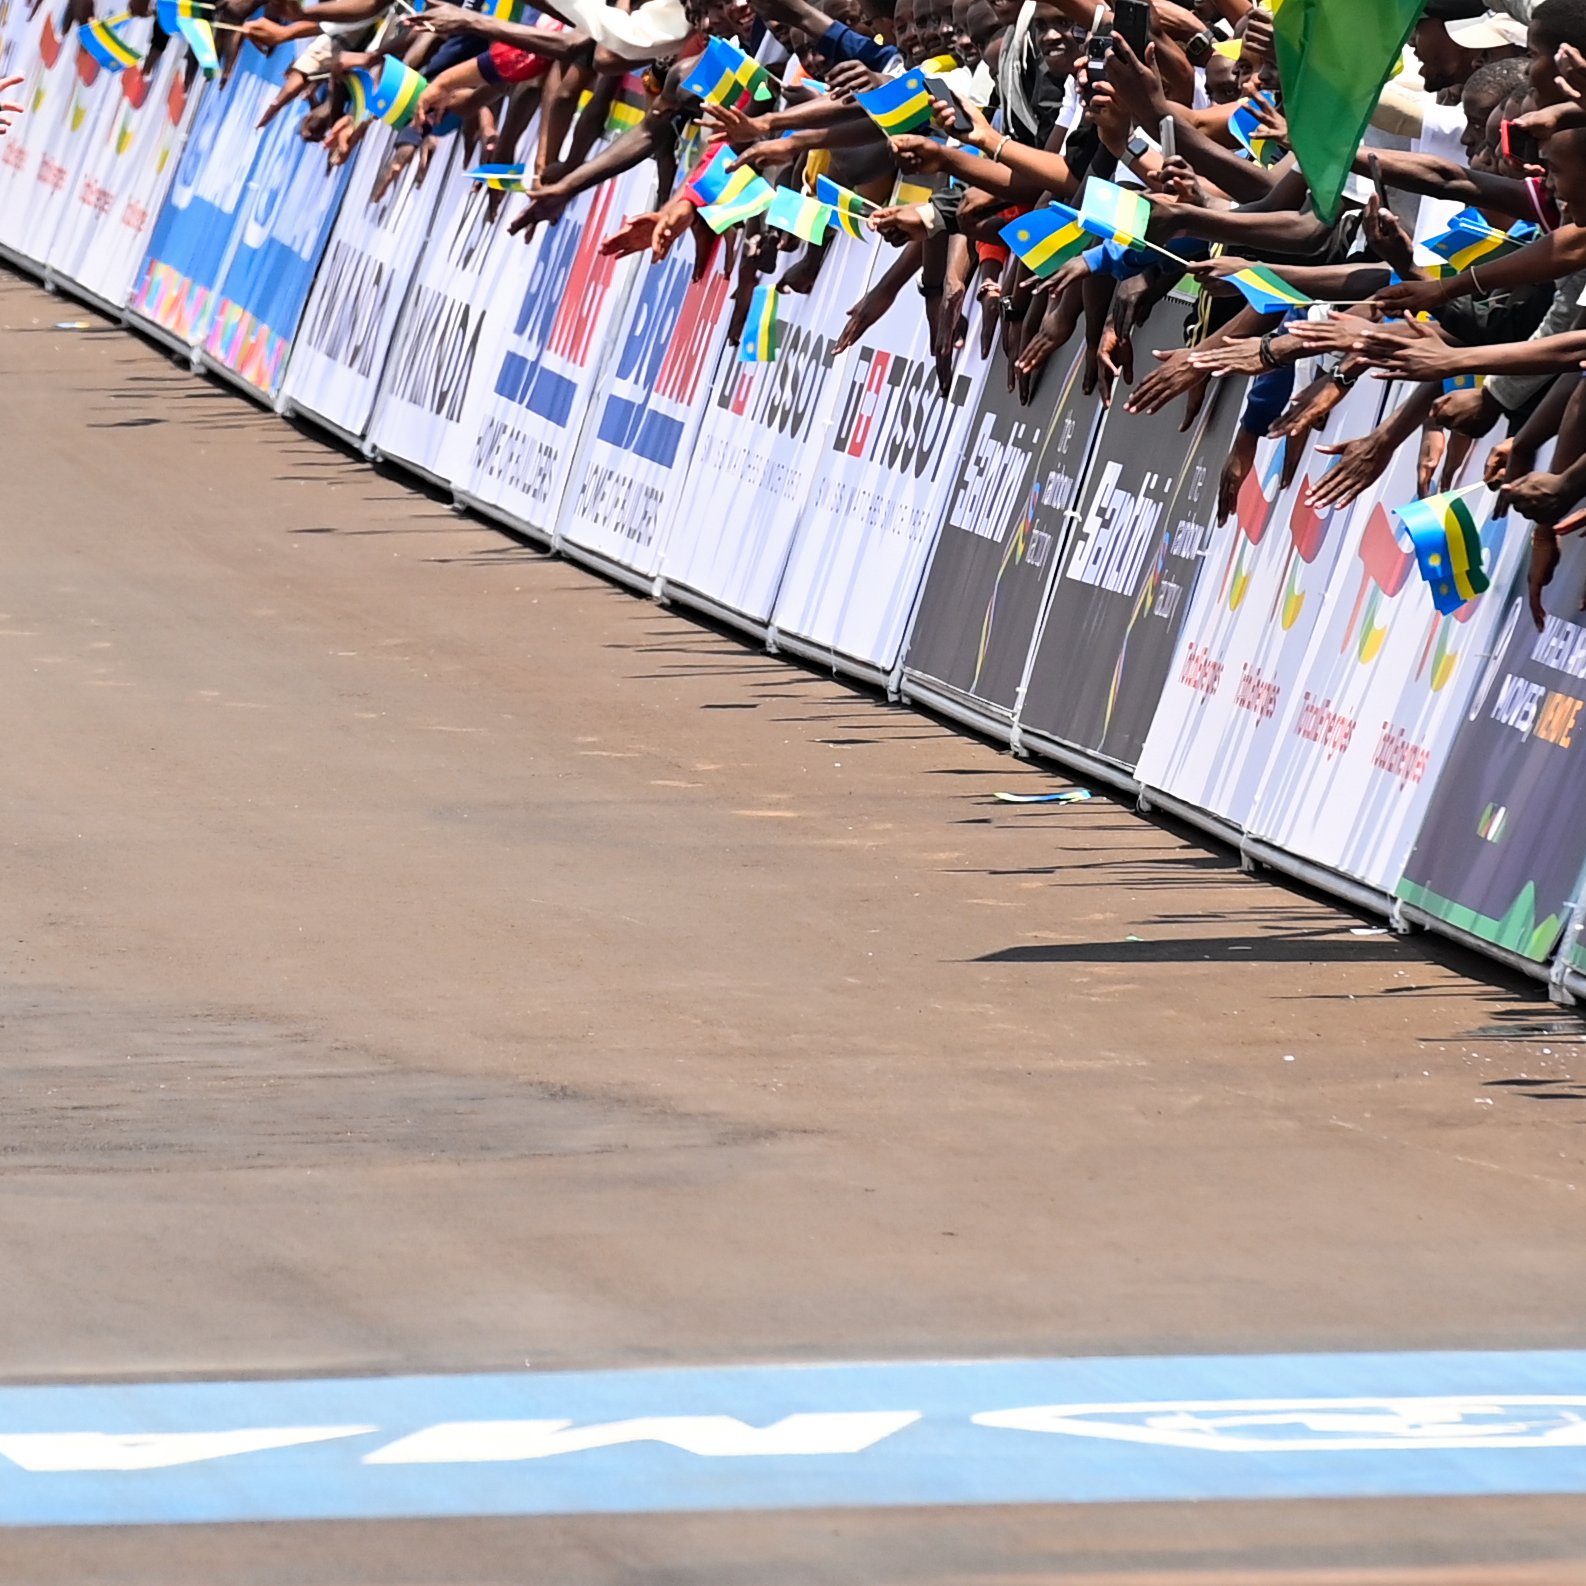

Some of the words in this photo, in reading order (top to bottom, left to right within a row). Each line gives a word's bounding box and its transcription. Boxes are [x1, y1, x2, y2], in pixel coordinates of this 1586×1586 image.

[751, 318, 839, 444] TISSOT
[869, 354, 973, 484] TISSOT
[950, 412, 1042, 543] Santini
[1066, 461, 1173, 596] Santini
